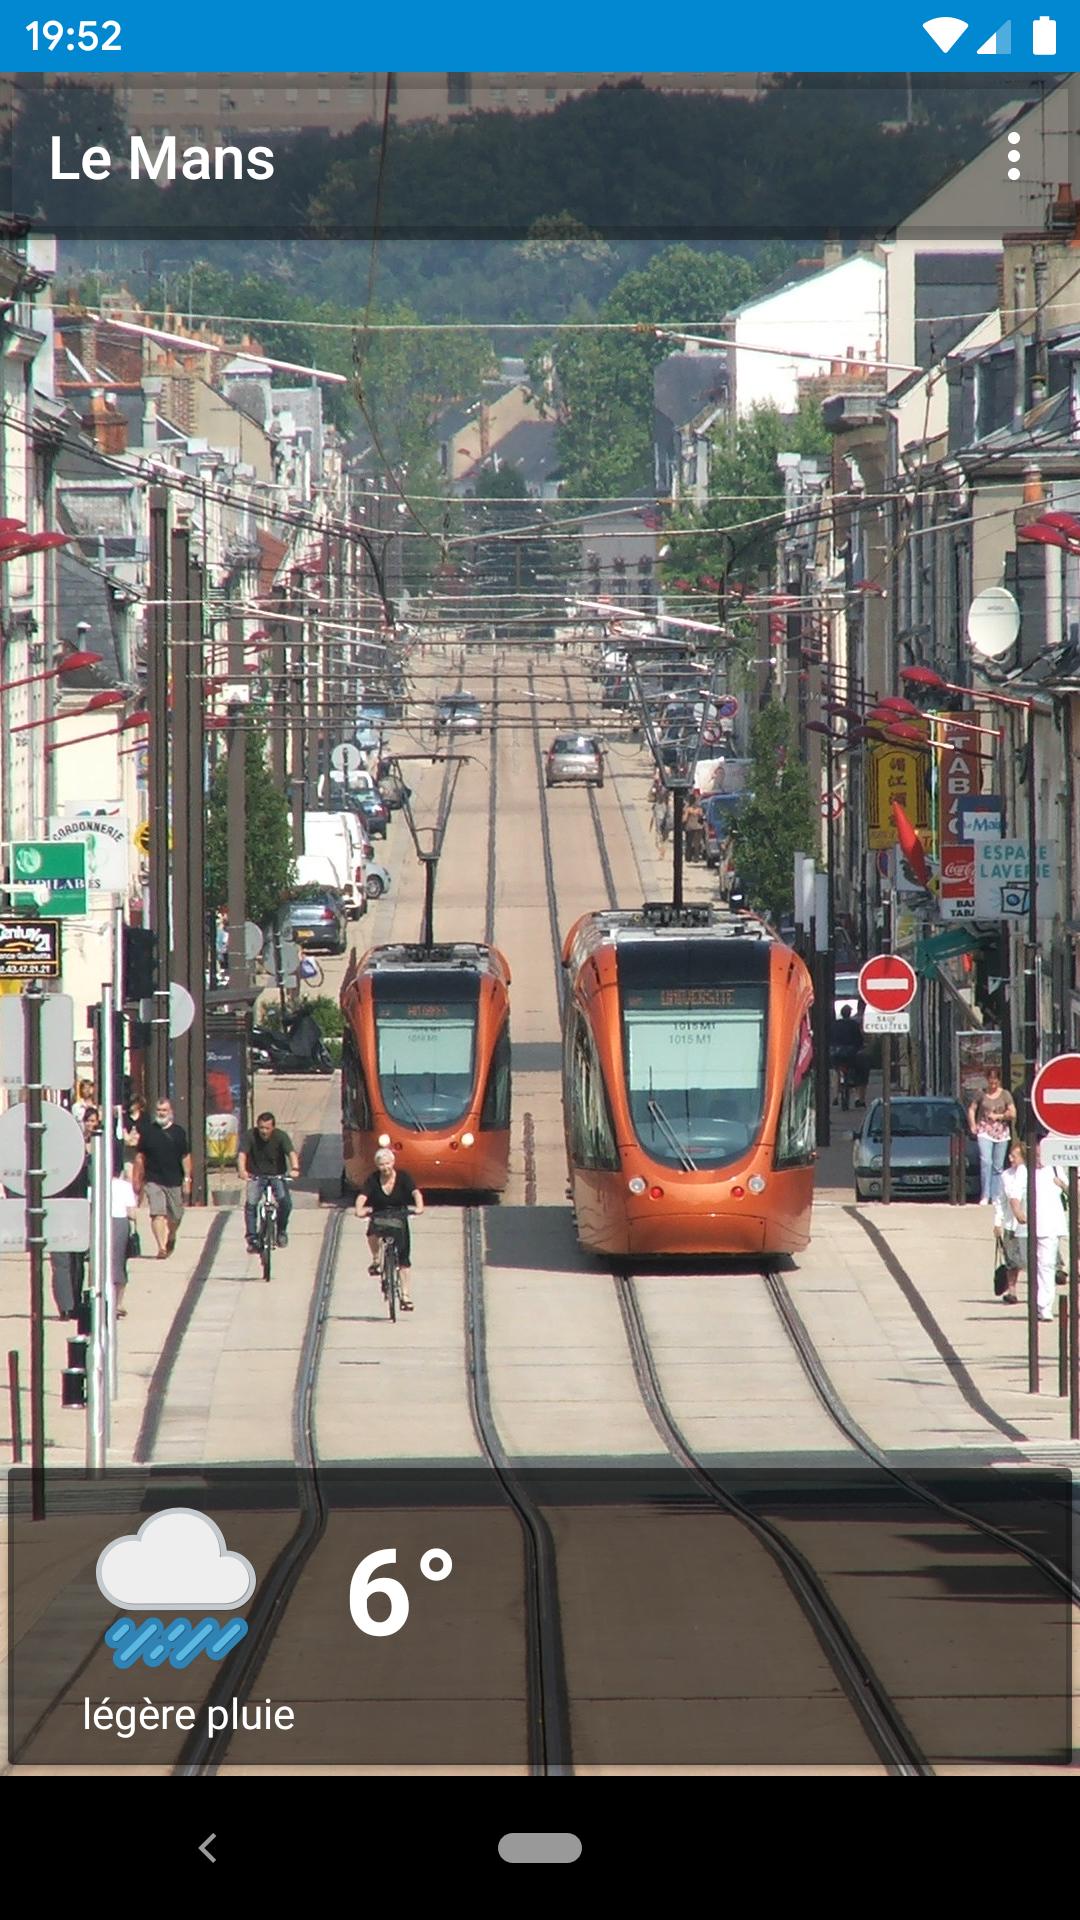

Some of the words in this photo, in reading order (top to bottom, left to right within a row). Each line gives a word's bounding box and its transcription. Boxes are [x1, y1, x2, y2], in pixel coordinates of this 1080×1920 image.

[52, 820, 125, 843] CORDONNERIE
[983, 846, 1048, 860] ESPAE
[35, 933, 51, 952] 21
[669, 1034, 694, 1044] 1015
[696, 1034, 712, 1044] M1
